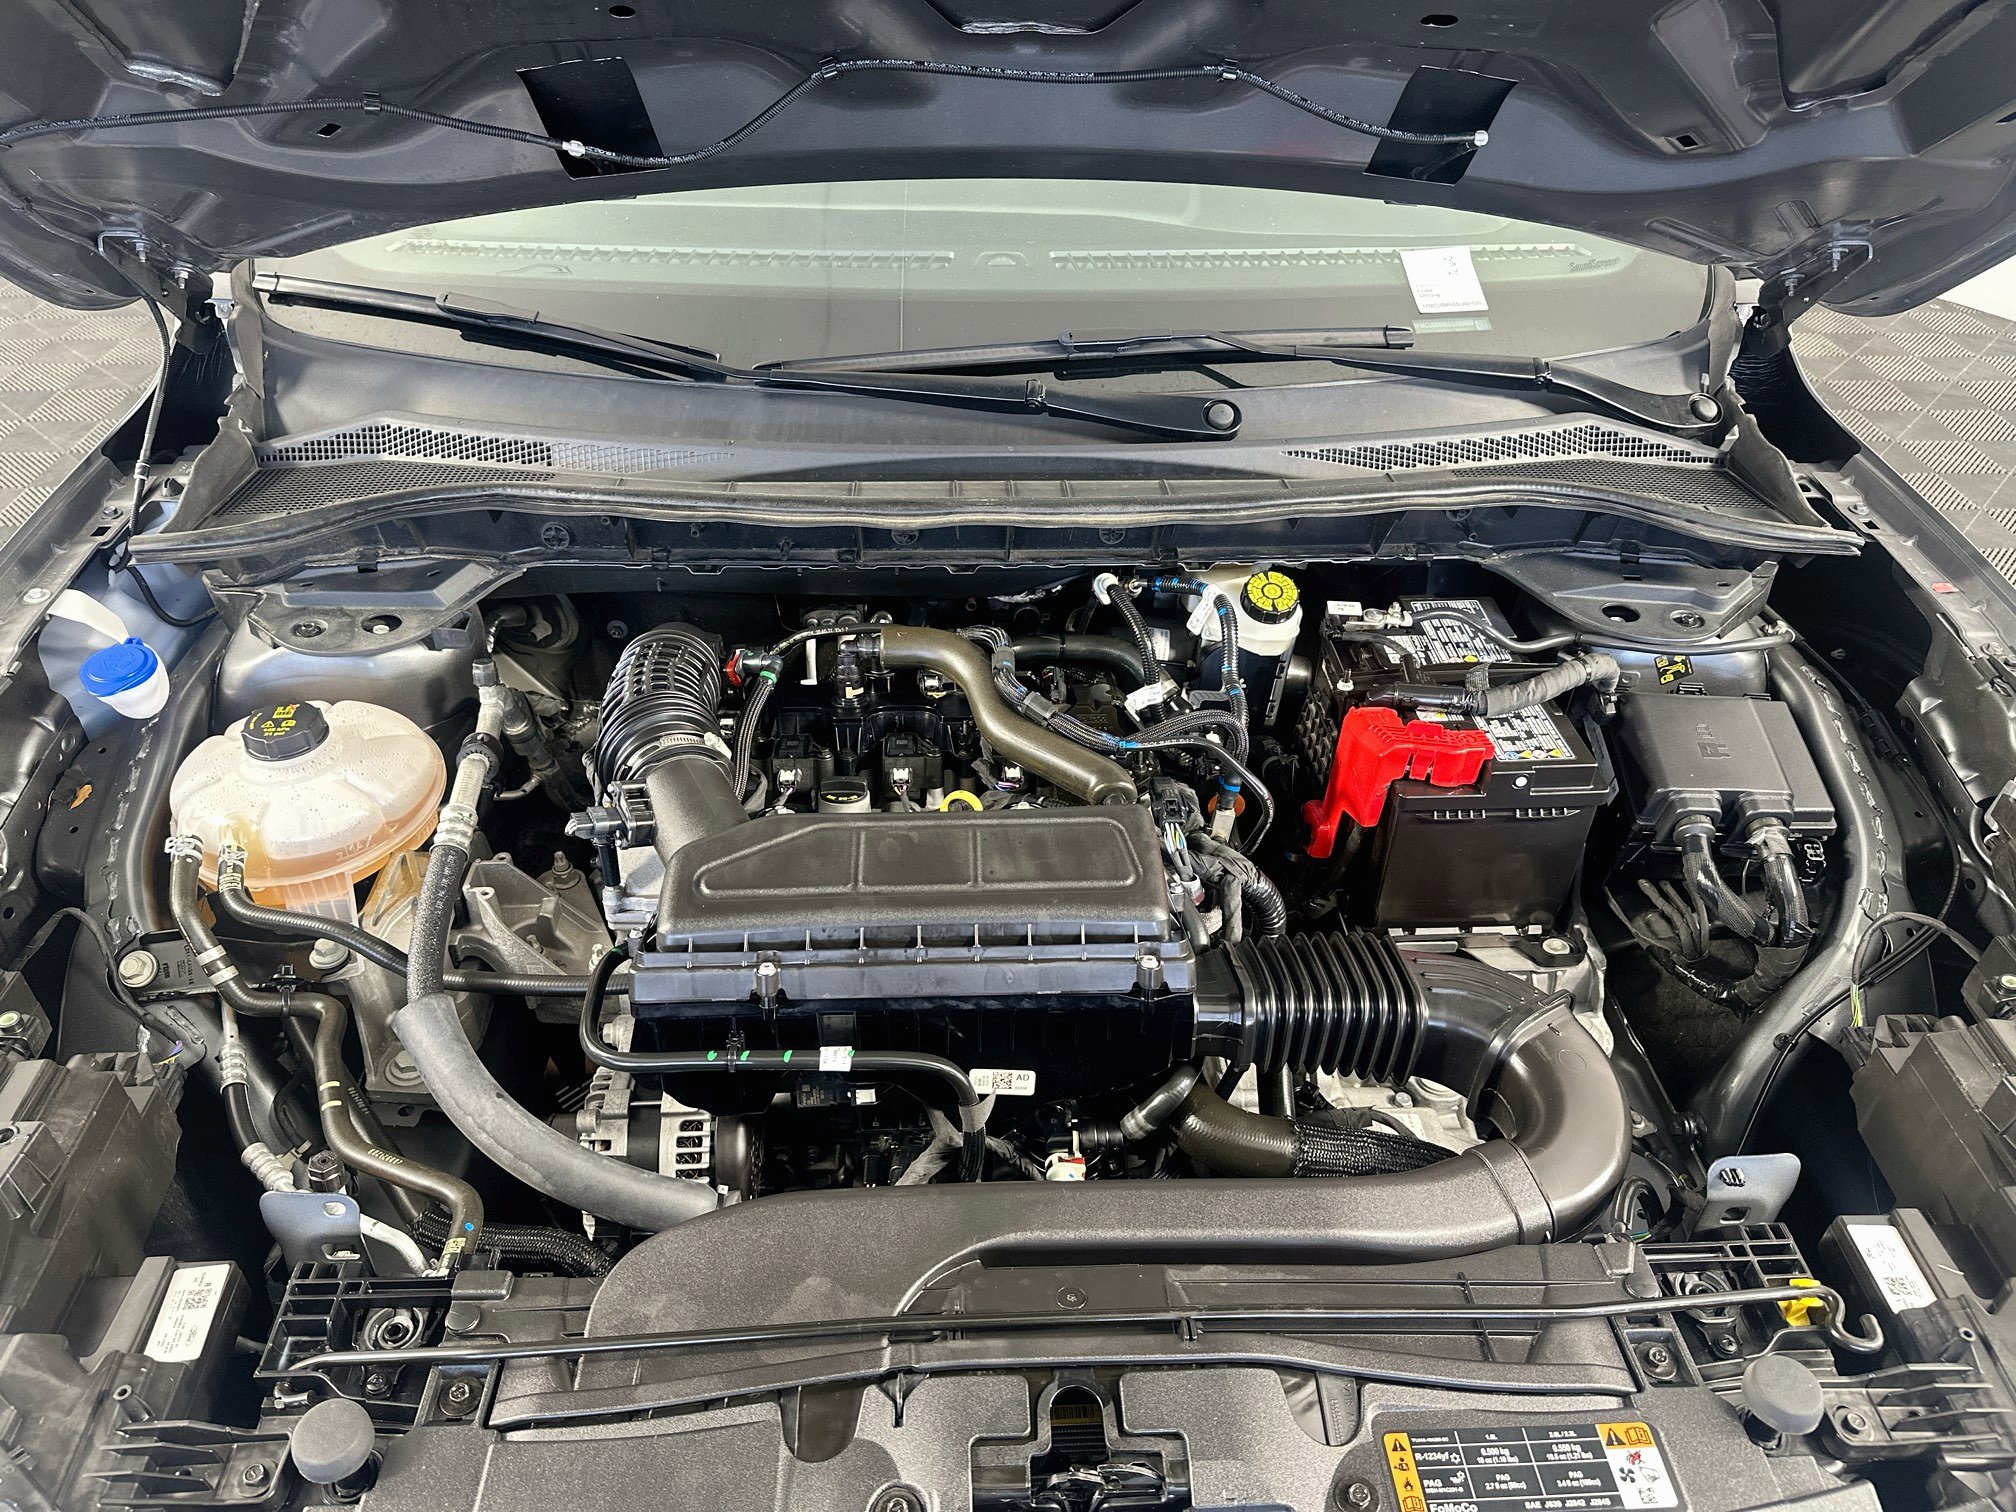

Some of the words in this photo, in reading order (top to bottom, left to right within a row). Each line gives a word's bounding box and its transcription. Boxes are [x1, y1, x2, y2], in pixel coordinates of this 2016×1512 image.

[1015, 1074, 1030, 1082] AD
[1499, 1447, 1510, 1456] kg
[1572, 1443, 1582, 1452] kg
[1495, 1473, 1511, 1481] PAG
[1423, 1479, 1442, 1487] PAG
[1429, 1502, 1479, 1512] FoMoCo
[1524, 1501, 1542, 1509] SAE
